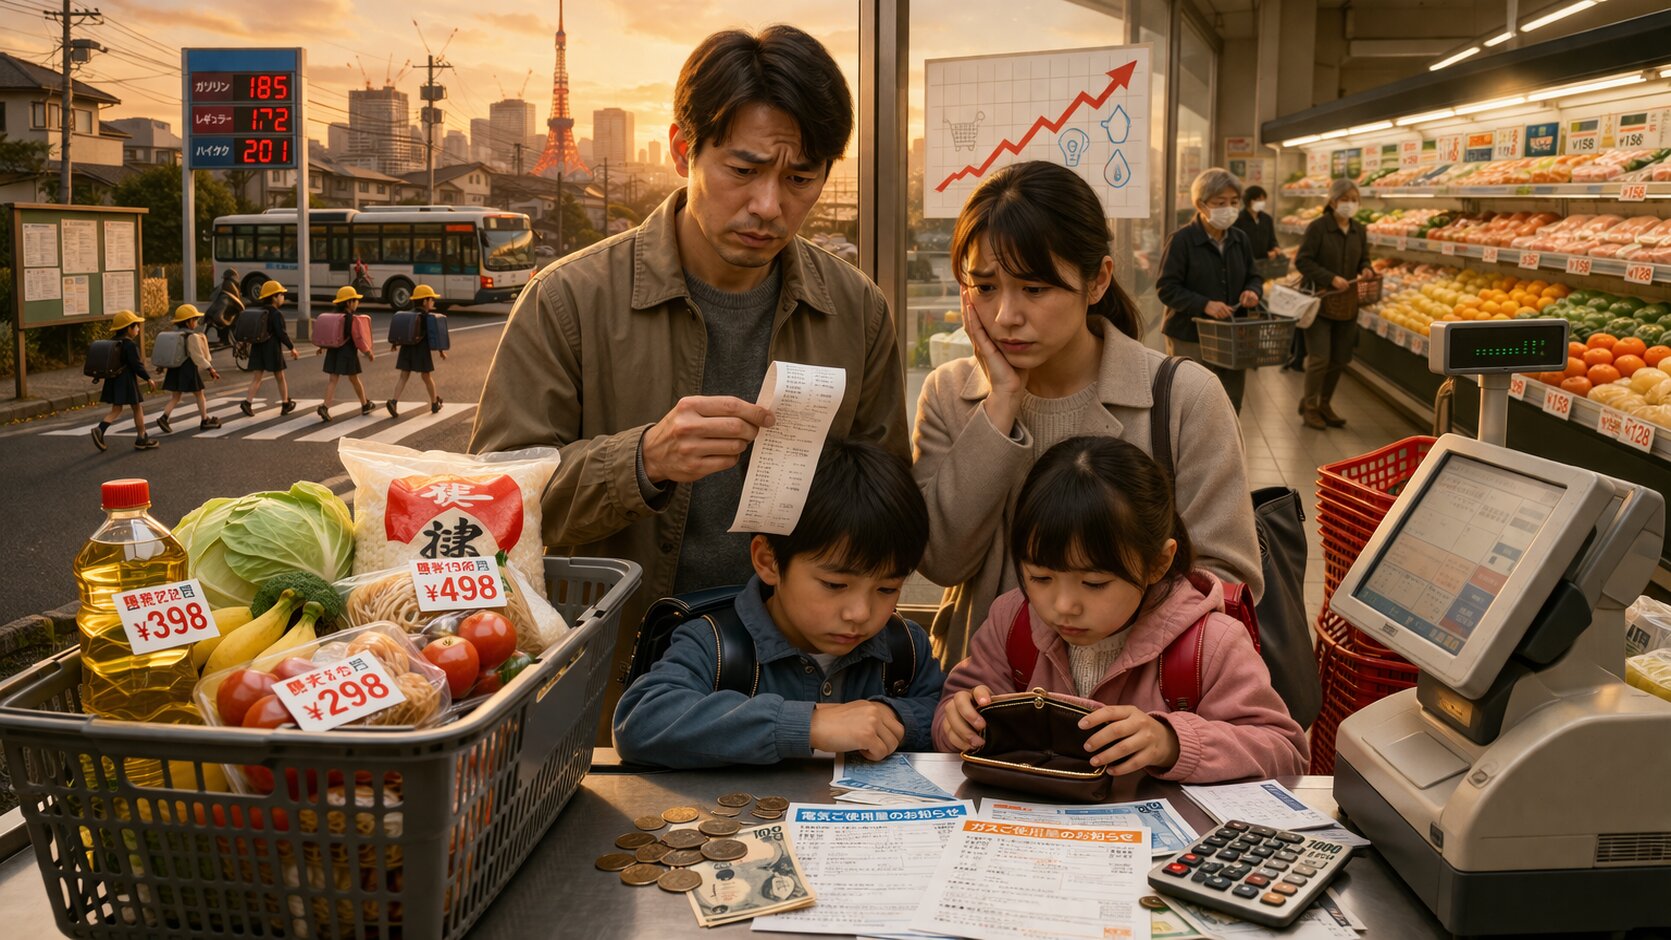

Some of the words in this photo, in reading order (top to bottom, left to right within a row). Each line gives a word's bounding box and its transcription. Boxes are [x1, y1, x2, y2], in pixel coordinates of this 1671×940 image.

[195, 81, 230, 92] ガソリン
[250, 76, 287, 99] 185
[252, 107, 288, 131] 172
[243, 139, 287, 163] 201
[424, 575, 497, 602] ¥498
[134, 602, 208, 641] ¥398
[303, 673, 389, 721] ¥298
